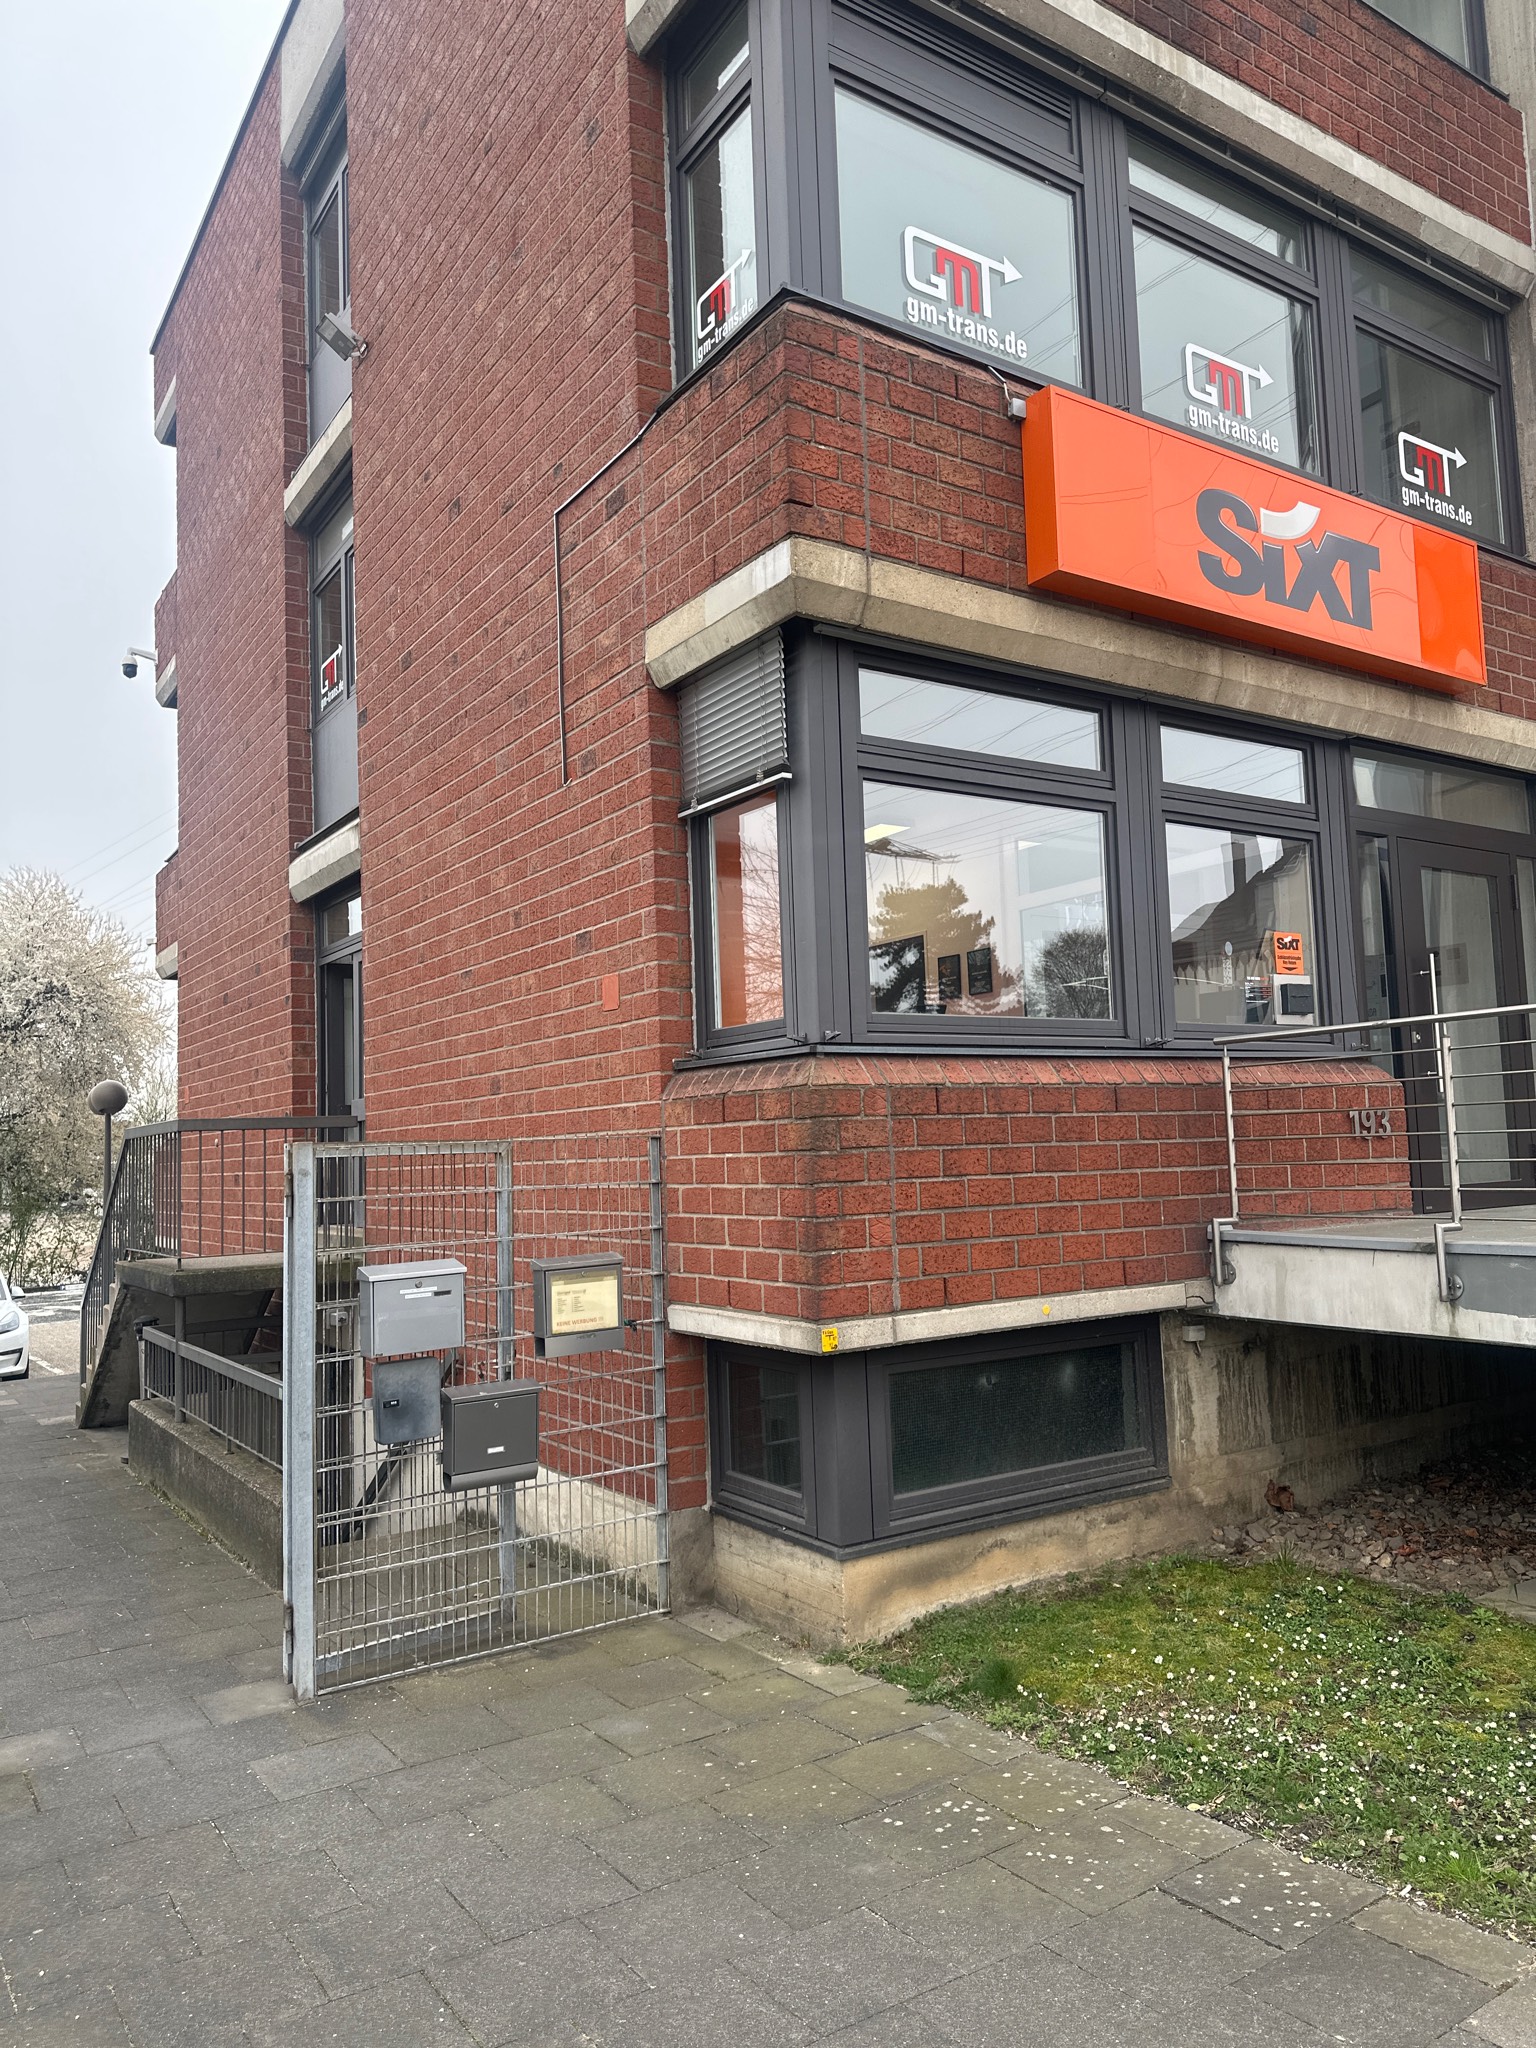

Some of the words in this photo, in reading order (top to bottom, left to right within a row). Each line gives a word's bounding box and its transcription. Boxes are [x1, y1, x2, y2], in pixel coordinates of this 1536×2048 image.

[697, 296, 755, 363] gm-trans.de
[907, 295, 1029, 359] gm-trans.de
[1188, 404, 1280, 453] gm-trans.de
[1401, 486, 1473, 526] gm-trans.de
[1195, 487, 1381, 632] SIXT
[1276, 935, 1300, 951] SIXT
[1349, 1109, 1392, 1140] 193
